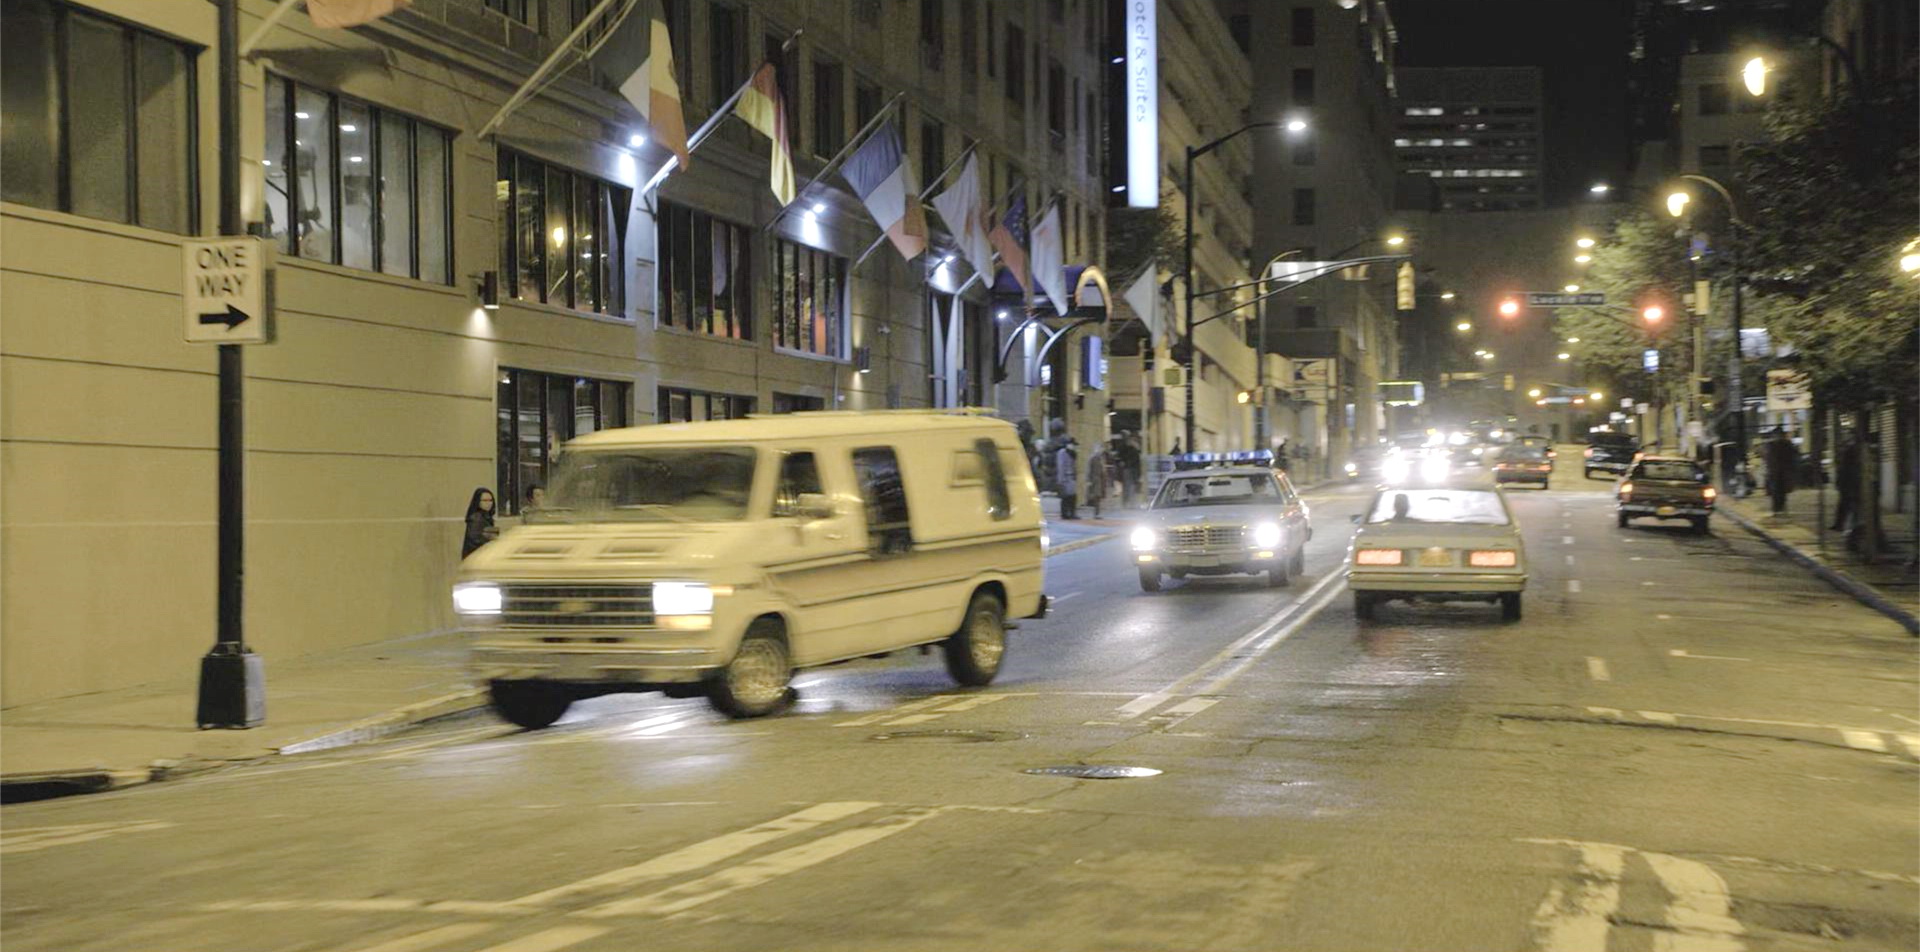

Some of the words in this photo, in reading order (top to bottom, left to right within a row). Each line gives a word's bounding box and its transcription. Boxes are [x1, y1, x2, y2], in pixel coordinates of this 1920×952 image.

[1135, 1, 1149, 40] otel
[1135, 46, 1147, 60] &
[1136, 66, 1148, 122] Suites
[195, 245, 247, 269] ONE
[195, 273, 248, 297] WAY
